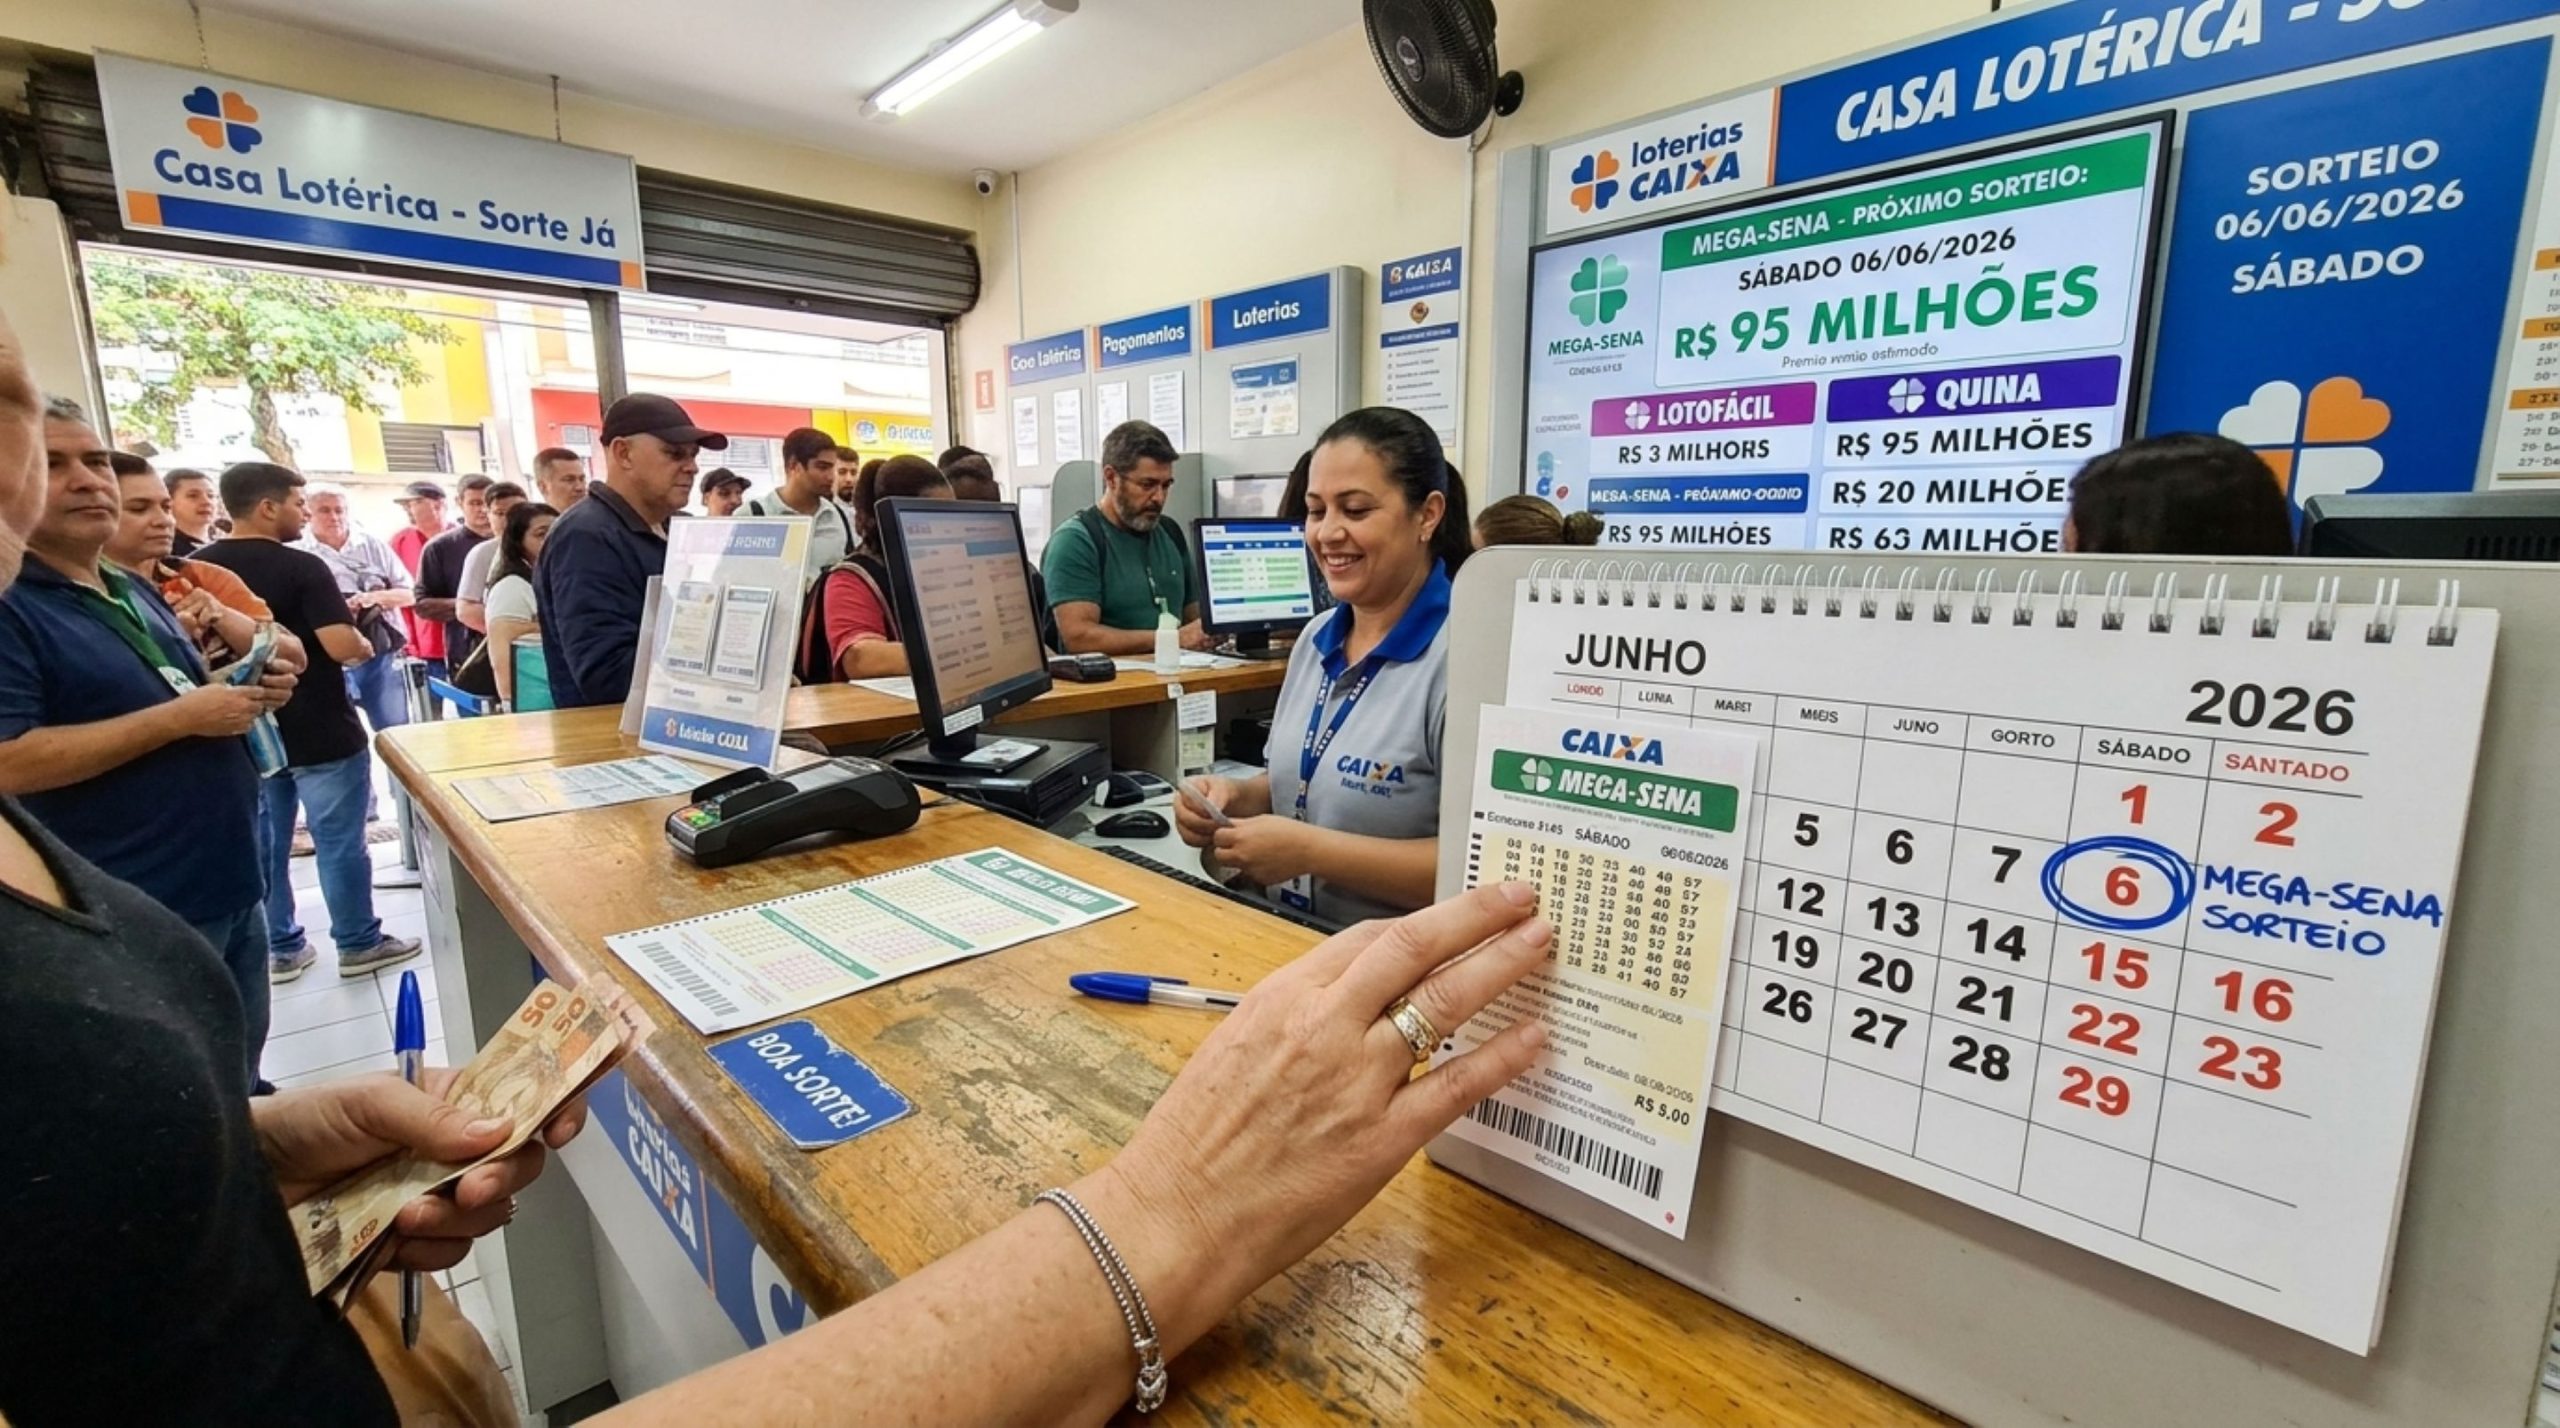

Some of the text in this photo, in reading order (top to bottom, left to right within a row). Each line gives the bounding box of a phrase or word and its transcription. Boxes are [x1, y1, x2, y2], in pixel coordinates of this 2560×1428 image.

[1836, 0, 2319, 143] CASA LOTÉRICA -
[1632, 121, 1743, 168] loterias
[2247, 137, 2442, 196] SORTEIO
[153, 148, 616, 249] Casa Lotérica - Sorte Já
[1629, 151, 1740, 203] CAIXA
[1691, 210, 1830, 258] MEGA-SENA
[1852, 186, 1963, 226] PRÓXIMO
[1970, 164, 2090, 205] SORTEIO:
[2215, 178, 2466, 243] 06/06/2026
[1738, 227, 2016, 291] SÁBADO 06/06/2026
[2231, 243, 2427, 295] SÁBADO
[1233, 298, 1300, 330] Loterias
[1674, 263, 2100, 361] R$ 95 MILHÕES
[1547, 330, 1645, 357] MEGA-SENA
[1657, 394, 1775, 427] LOTOFÁCIL
[1935, 373, 2041, 410] QUINA
[1649, 446, 1661, 462] 3
[1836, 417, 2093, 460] R$ 95 MILHÕES
[1833, 479, 1867, 508] R$
[1878, 480, 1915, 504] 20
[1926, 470, 2068, 504] MILHÕE
[1639, 525, 1663, 543] 95
[1874, 527, 1911, 551] 63
[1922, 522, 2060, 552] MILHÕE
[1565, 633, 1706, 675] JUNHO
[2185, 680, 2355, 736] 2026
[1336, 755, 1405, 784] CAIXA
[1561, 728, 1664, 766] CAIXA
[1893, 720, 1939, 735] JUNO
[1991, 729, 2055, 748] GORTO
[2098, 739, 2191, 764] SÁBADO
[2226, 752, 2349, 781] SANTADO
[2121, 785, 2299, 847] 1 2
[1794, 814, 2140, 906] 5 6 7 6
[2203, 865, 2444, 927] MEGA-SENA
[1777, 878, 2294, 1023] 12 13 14 15 16
[2202, 905, 2386, 956] SORTEIO
[522, 991, 558, 1029] 50
[551, 996, 586, 1037] 50
[1771, 930, 2283, 1090] 19 20 21 22 23
[1763, 982, 2131, 1117] 26 27 28 29
[747, 1031, 871, 1130] BOA SORTE!
